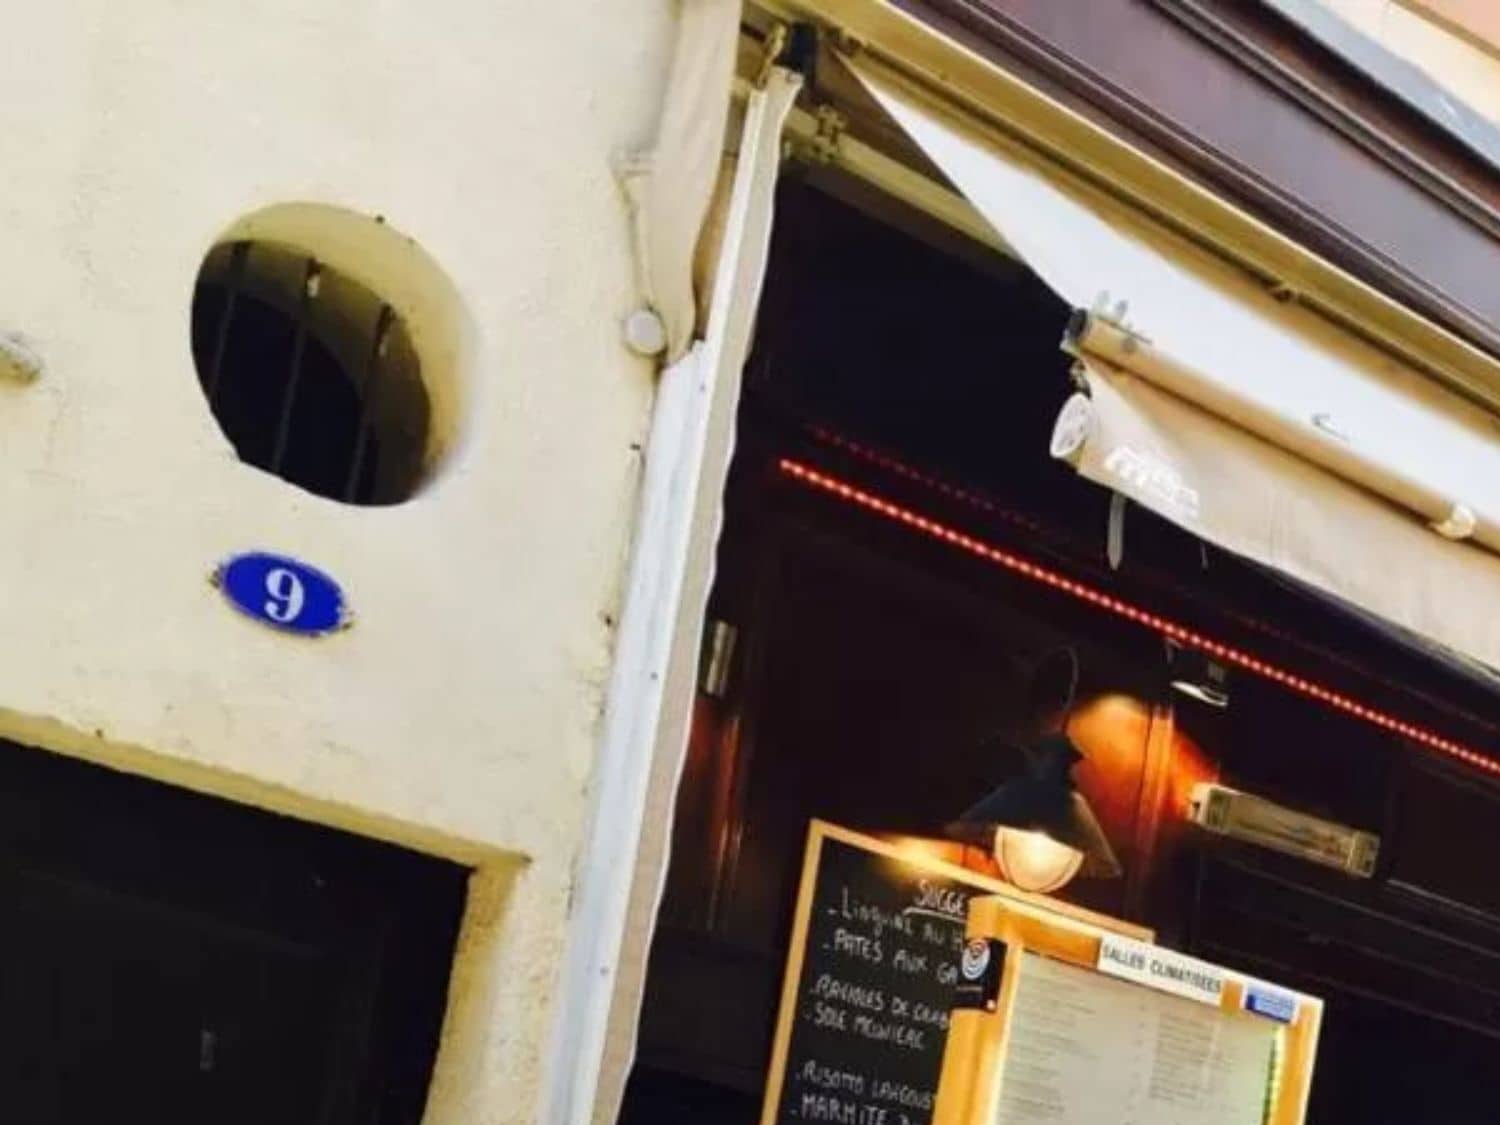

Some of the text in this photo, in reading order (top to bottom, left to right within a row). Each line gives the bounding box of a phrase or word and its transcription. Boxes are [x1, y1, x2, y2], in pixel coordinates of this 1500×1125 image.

[265, 568, 304, 623] 9
[1103, 944, 1146, 971] SALLES
[891, 996, 910, 1016] DE
